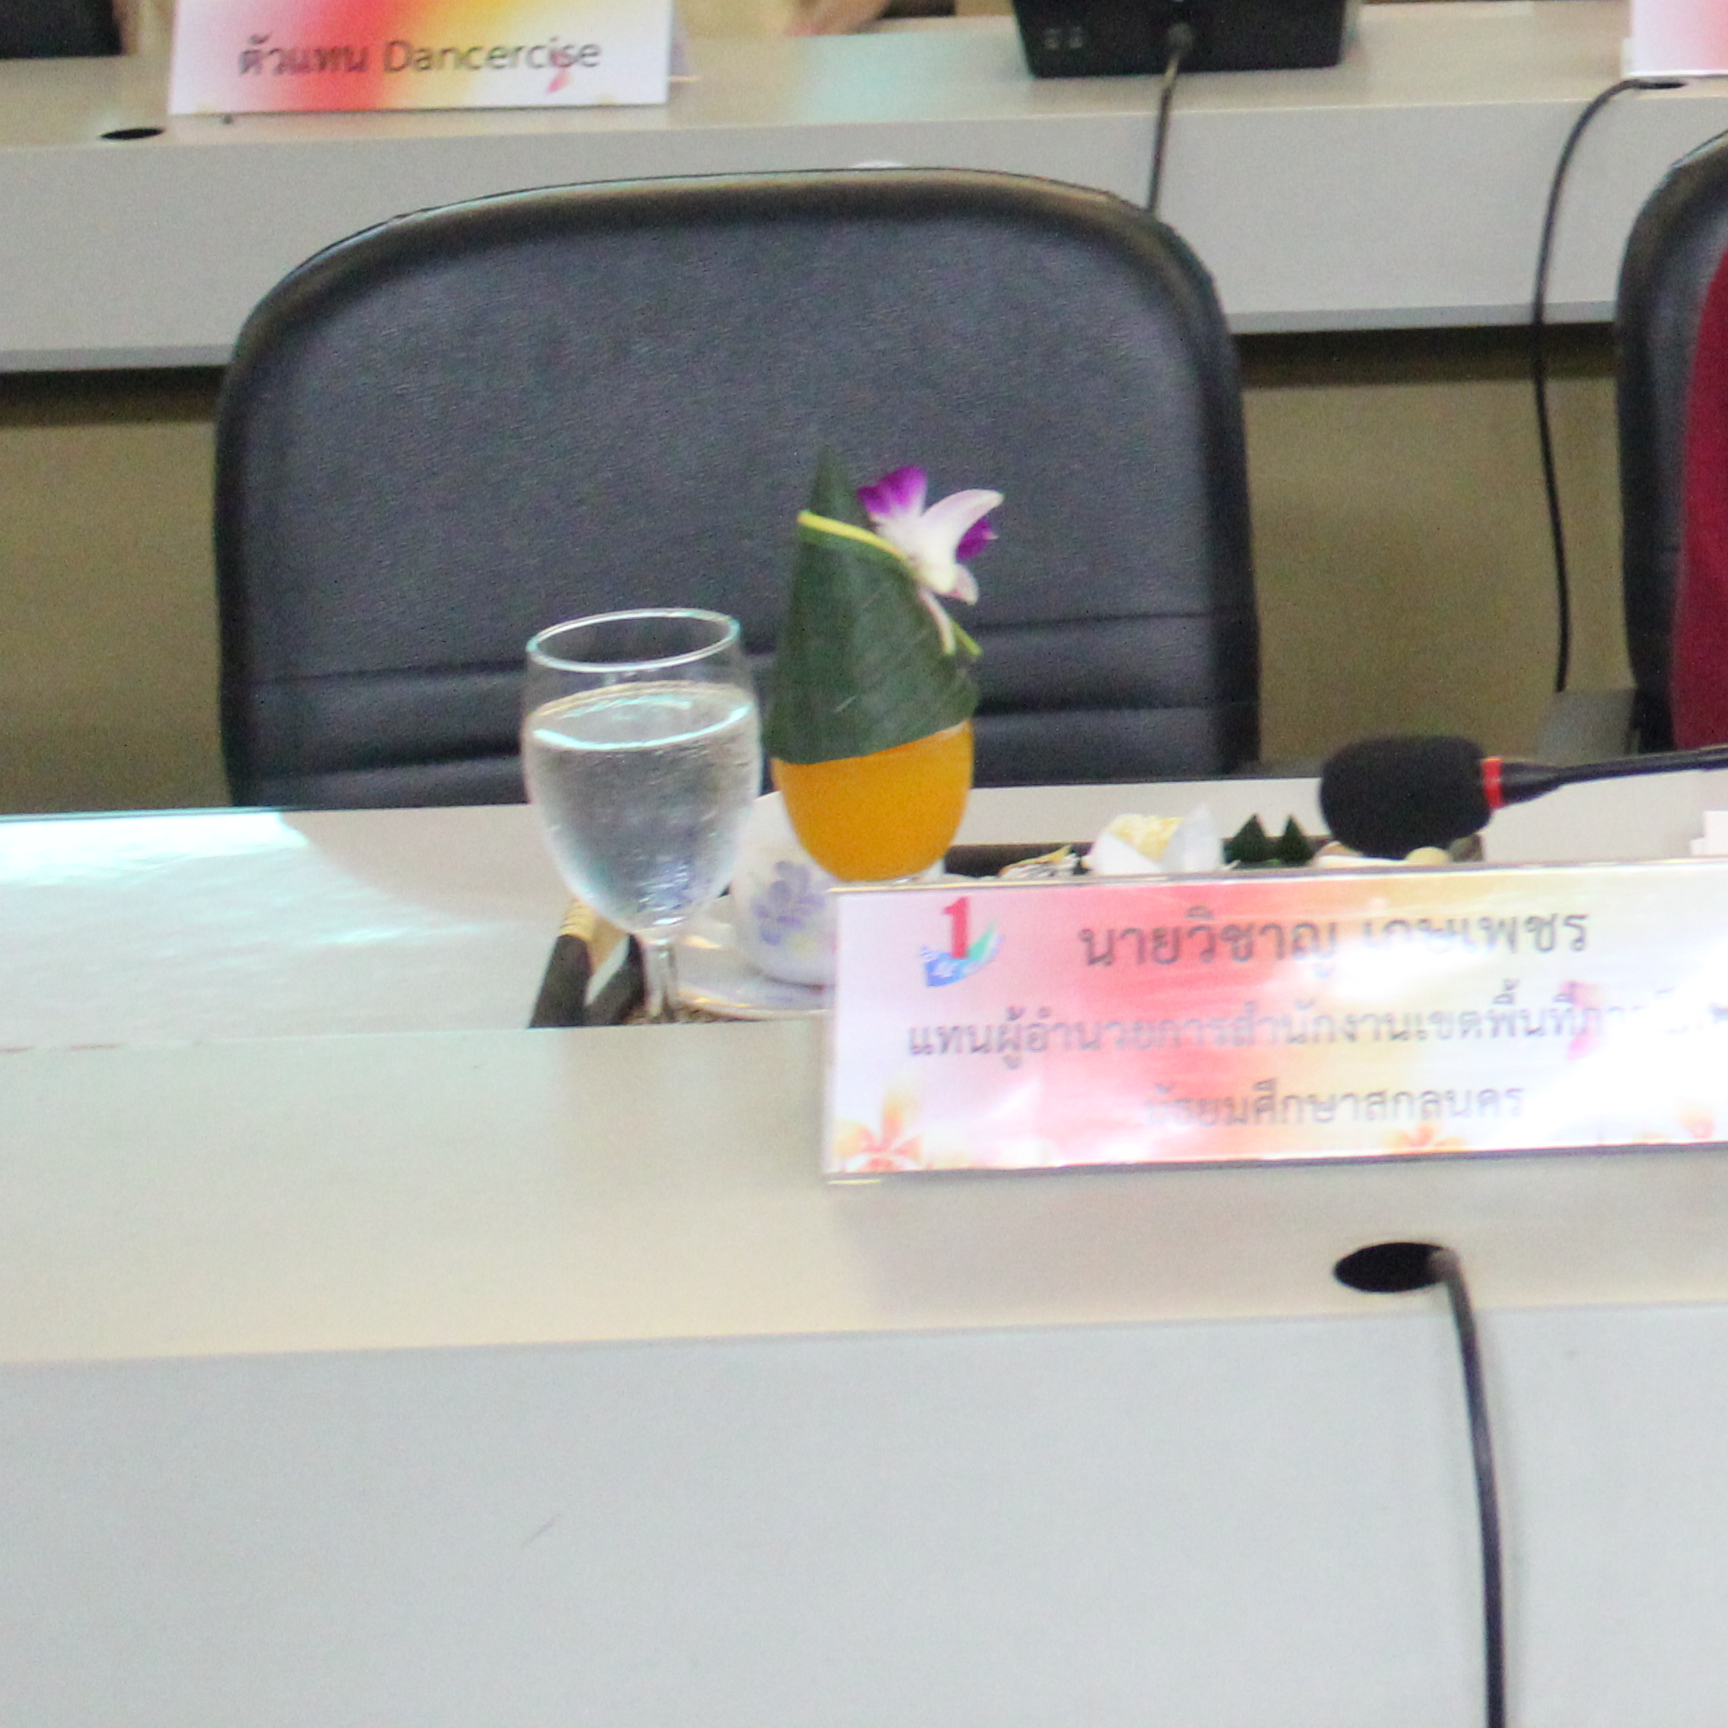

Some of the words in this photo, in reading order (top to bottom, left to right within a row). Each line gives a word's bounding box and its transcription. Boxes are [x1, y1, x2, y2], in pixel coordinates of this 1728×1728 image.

[238, 33, 366, 76] ตัวแทน
[384, 35, 602, 74] Dancercise
[1079, 905, 1337, 978] นายวิชาญ
